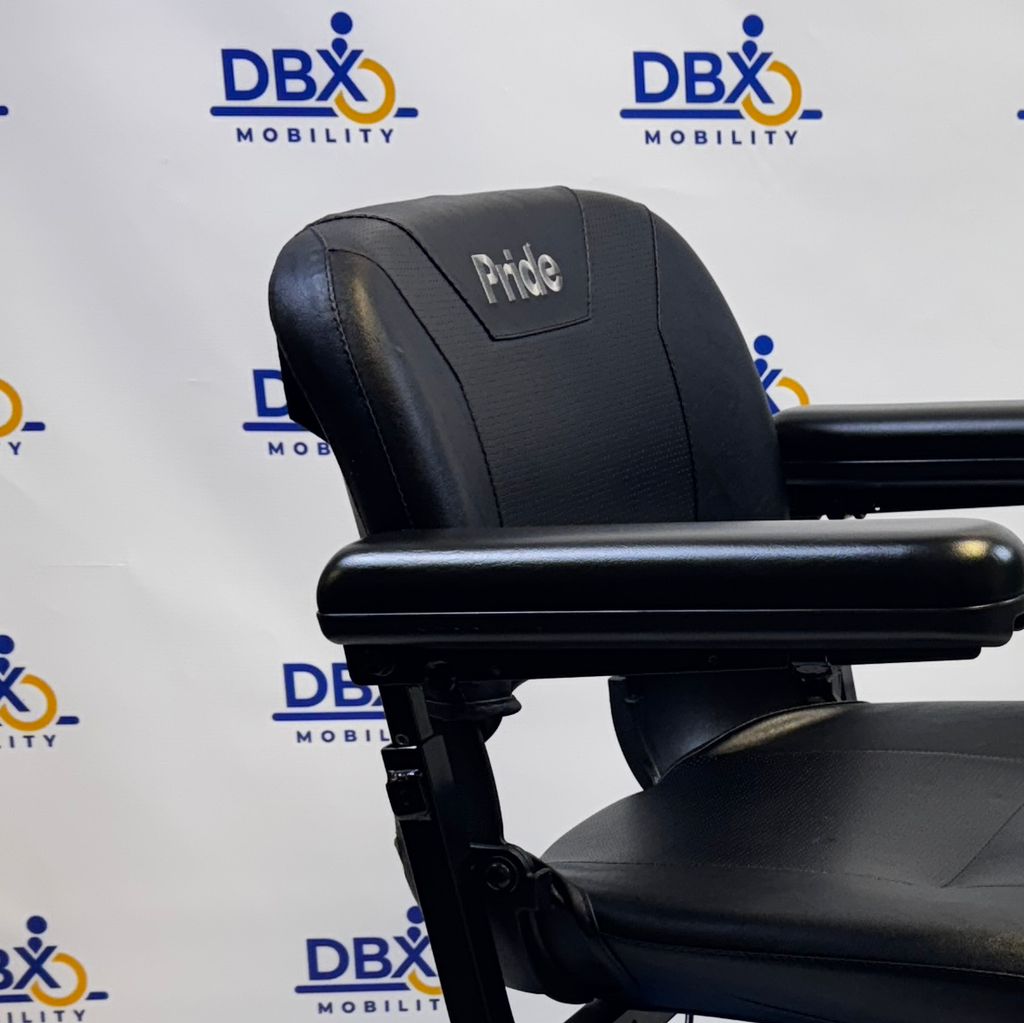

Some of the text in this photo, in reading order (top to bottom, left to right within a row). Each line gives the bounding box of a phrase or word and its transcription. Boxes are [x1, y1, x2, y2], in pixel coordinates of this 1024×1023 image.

[221, 49, 367, 102] DBX
[633, 51, 774, 104] DBX
[236, 128, 393, 143] MOBILITY
[645, 130, 797, 145] MOBILITY
[471, 242, 563, 304] Pride
[283, 663, 384, 707] DB
[296, 729, 390, 743] MOBIL
[306, 936, 437, 980] DBX
[7, 1009, 85, 1023] ILITY
[318, 999, 440, 1014] MOBILIT
